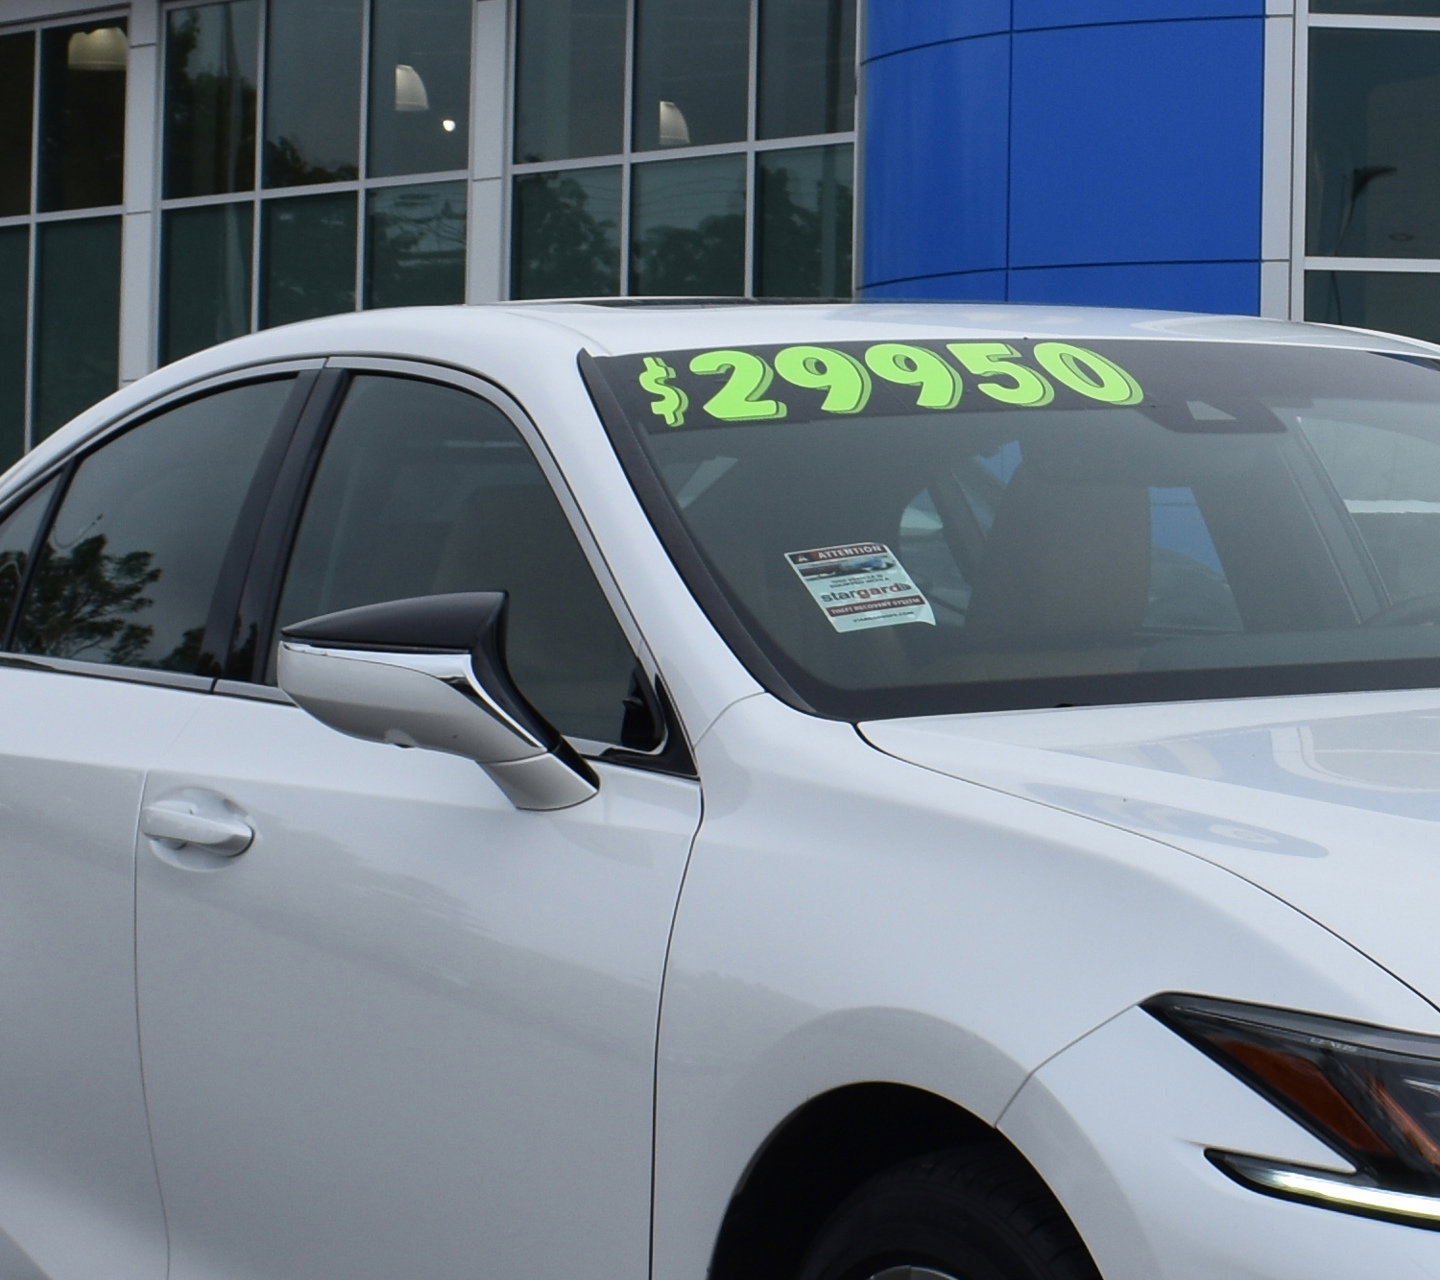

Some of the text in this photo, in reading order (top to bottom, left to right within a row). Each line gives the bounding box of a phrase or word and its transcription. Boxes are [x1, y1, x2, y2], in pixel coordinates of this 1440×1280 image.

[638, 341, 1144, 427] $29950
[817, 545, 883, 560] ATTENTION
[820, 582, 902, 603] stargard
